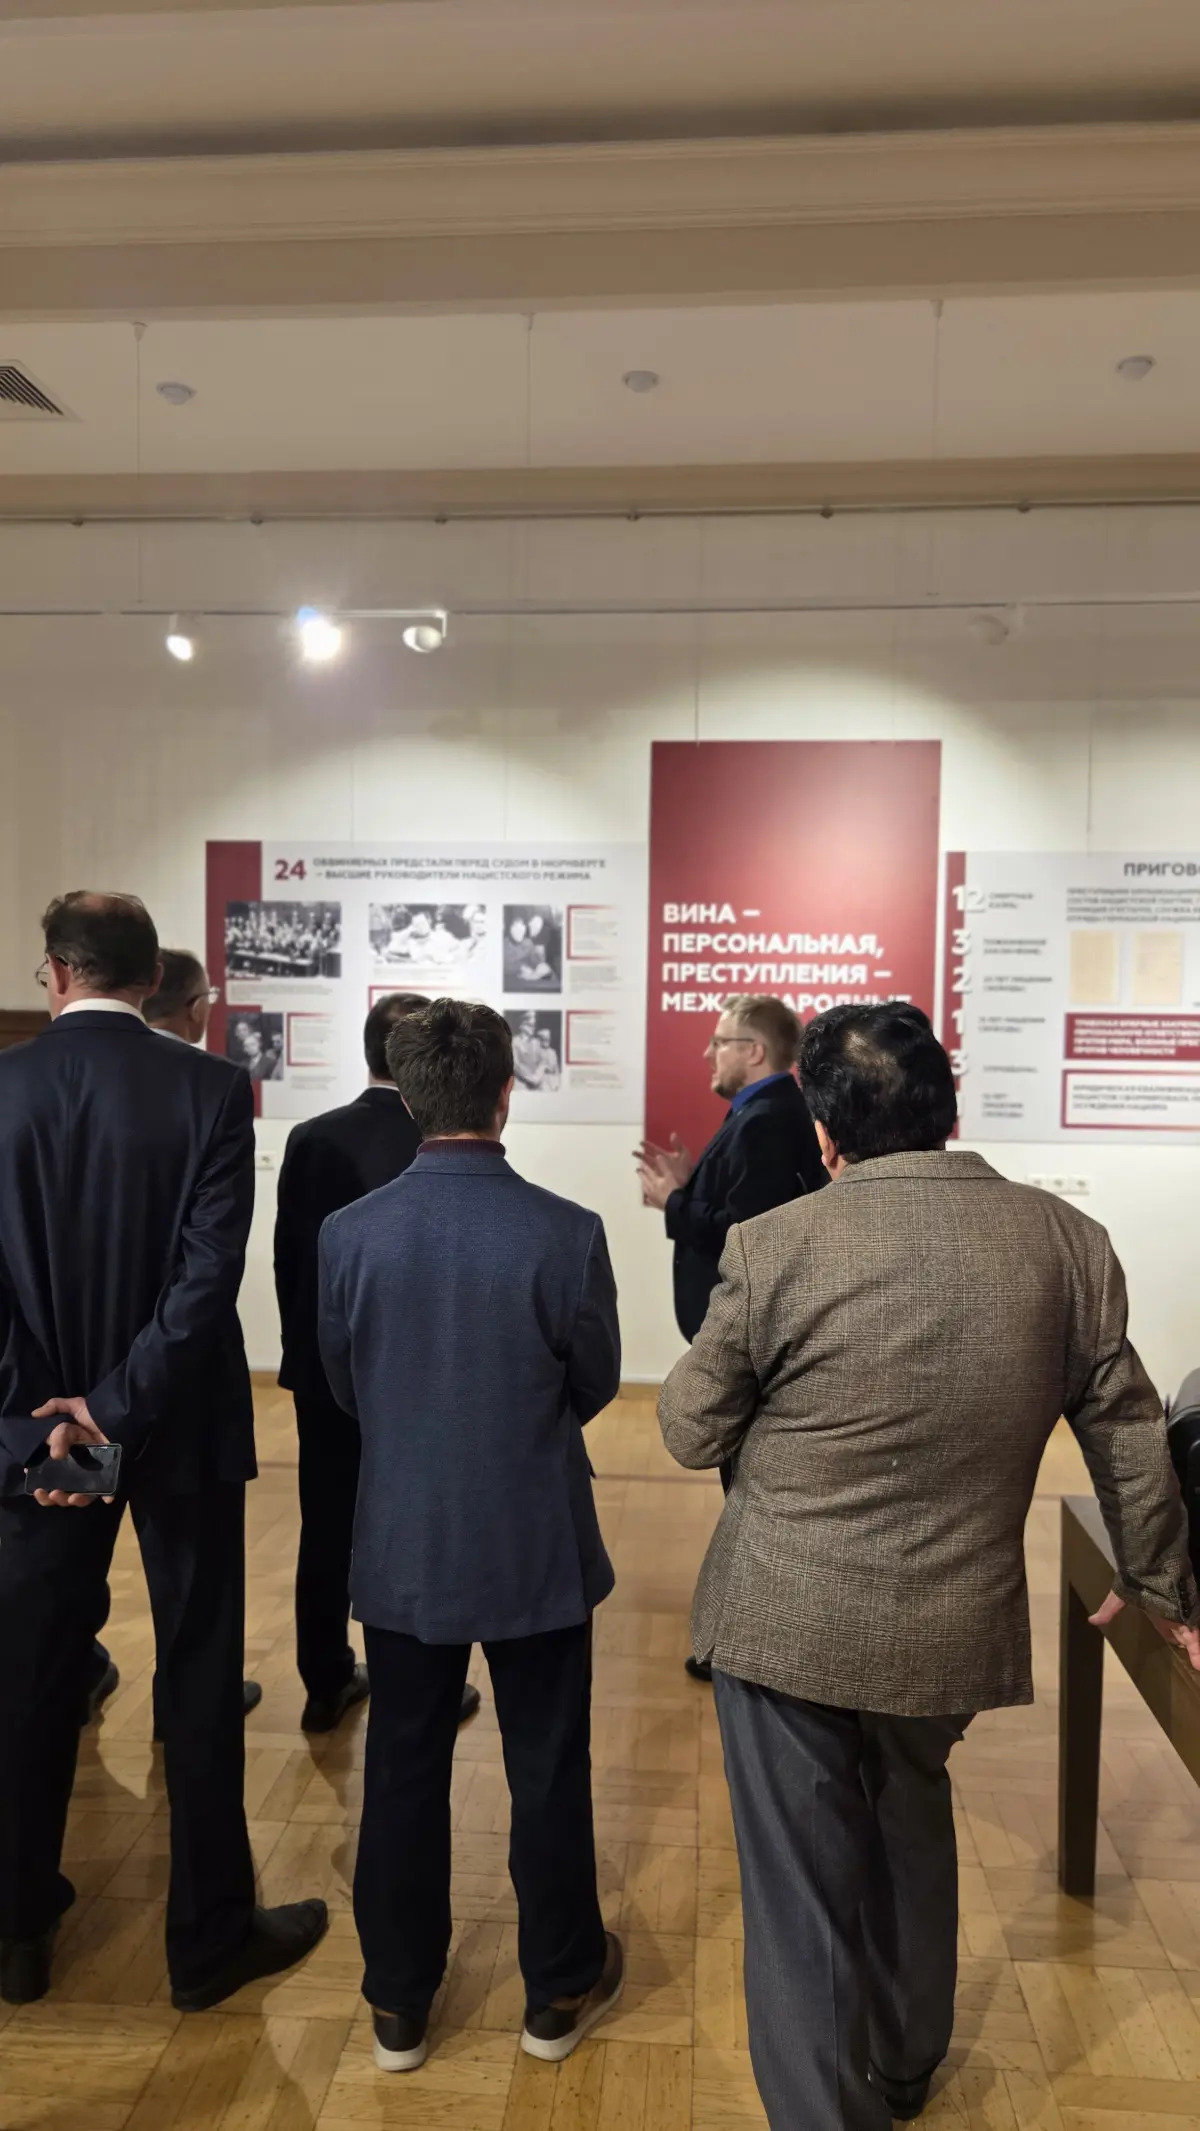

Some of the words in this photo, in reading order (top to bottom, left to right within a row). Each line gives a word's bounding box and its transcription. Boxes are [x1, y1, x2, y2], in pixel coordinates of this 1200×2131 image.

[274, 858, 307, 881] 24
[492, 859, 529, 868] СУДОМ
[952, 884, 985, 912] 12
[663, 903, 737, 924] ВИНА
[662, 932, 885, 959] ПЕРСОНАЛЬНАЯ,
[951, 929, 972, 955] 3
[661, 962, 868, 985] ПРЕСТУПЛЕНИЯ
[951, 966, 972, 993] 2
[951, 1010, 966, 1035] 1
[949, 1050, 969, 1076] 3
